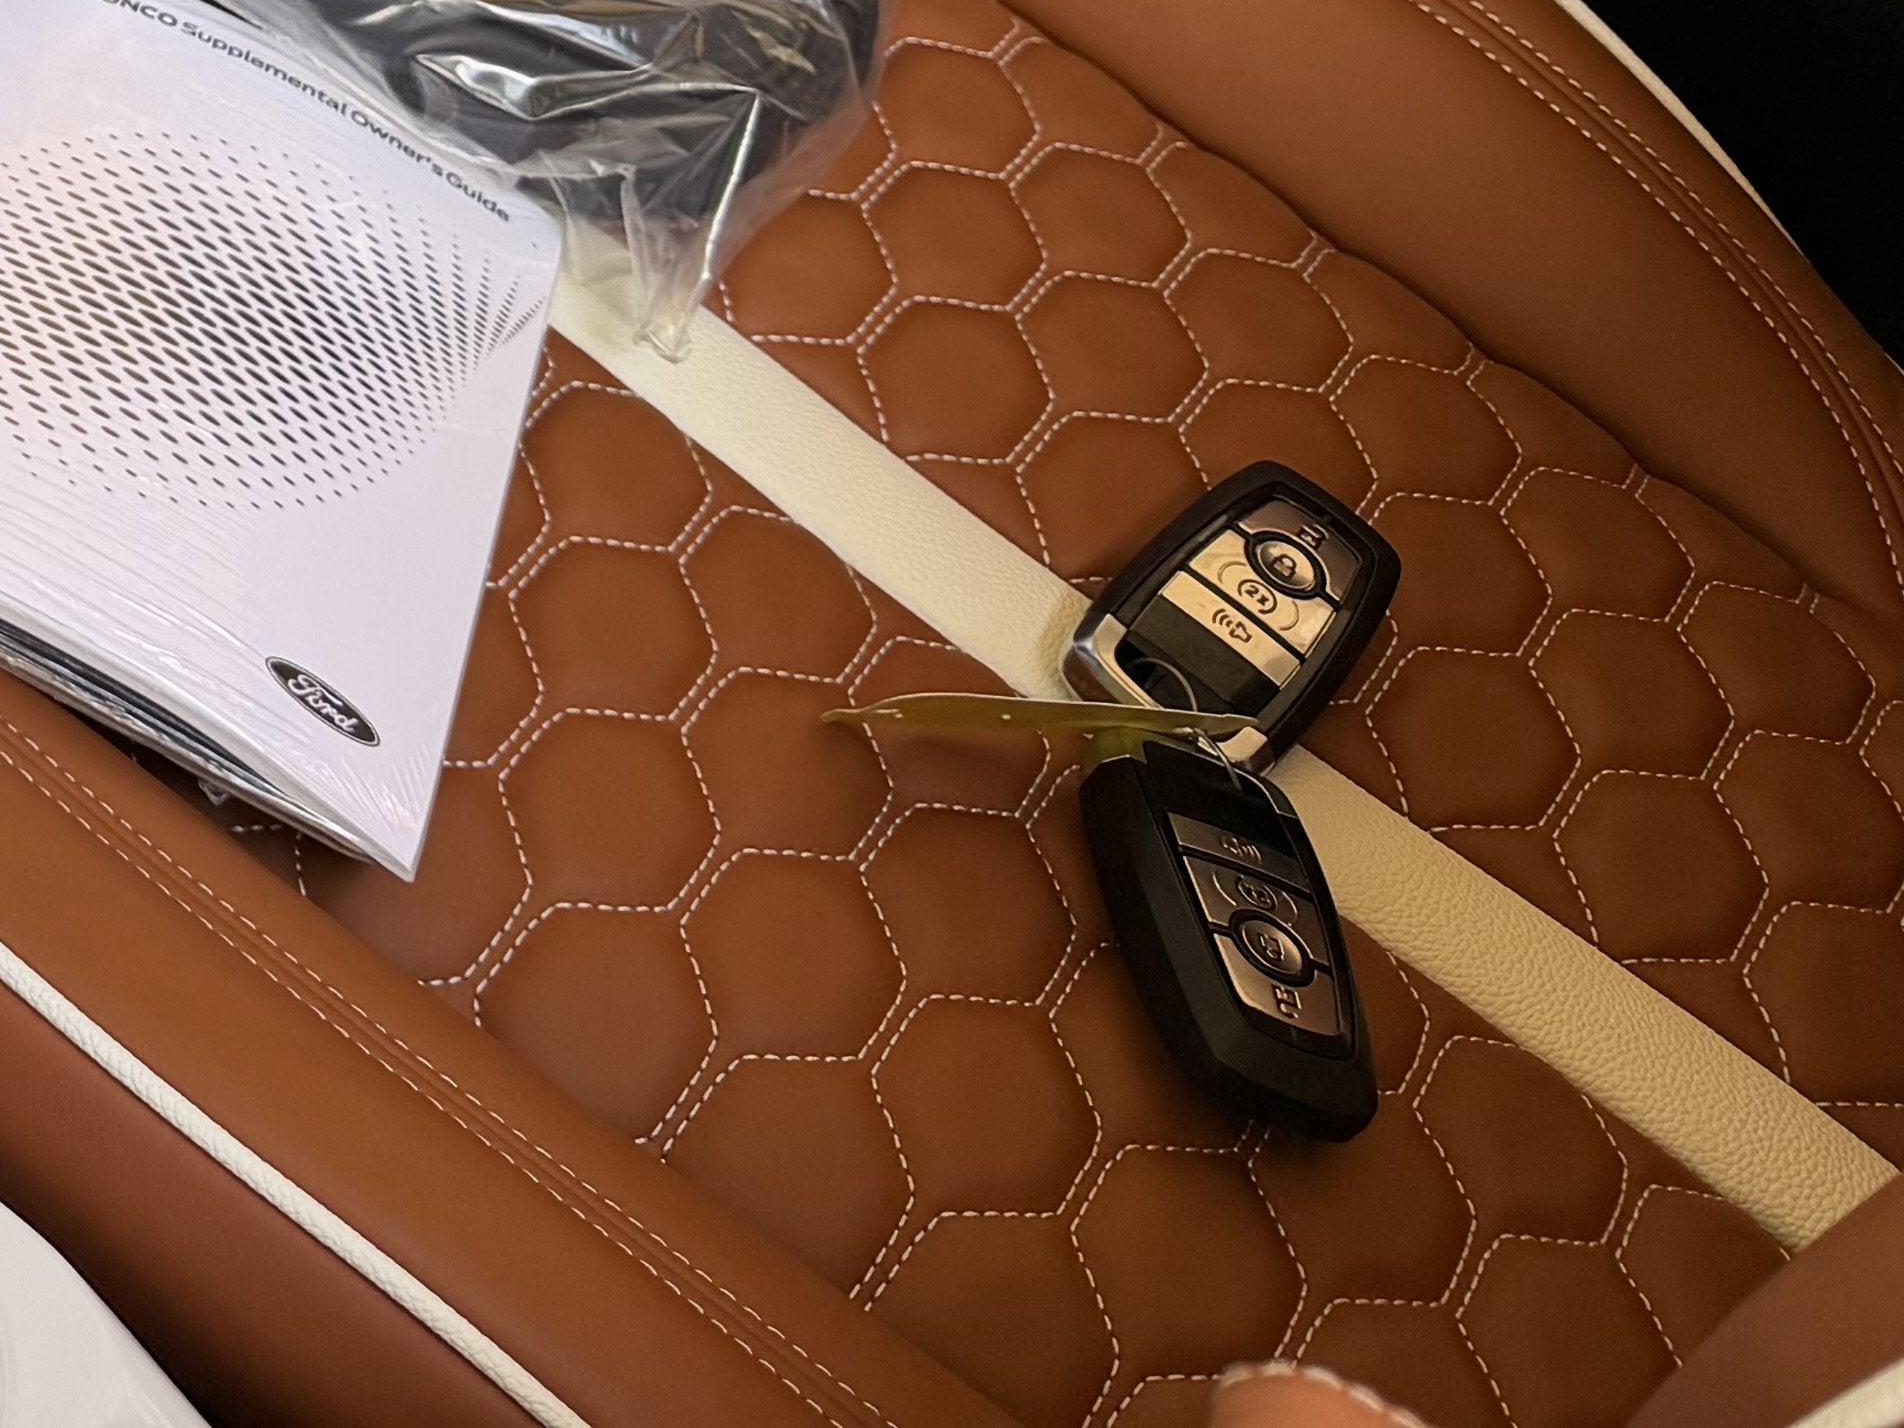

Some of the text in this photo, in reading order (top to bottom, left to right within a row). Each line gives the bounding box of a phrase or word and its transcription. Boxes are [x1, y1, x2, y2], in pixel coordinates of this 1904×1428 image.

[179, 19, 347, 116] Supplemental
[351, 109, 443, 177] Owner's
[446, 172, 510, 222] Guide
